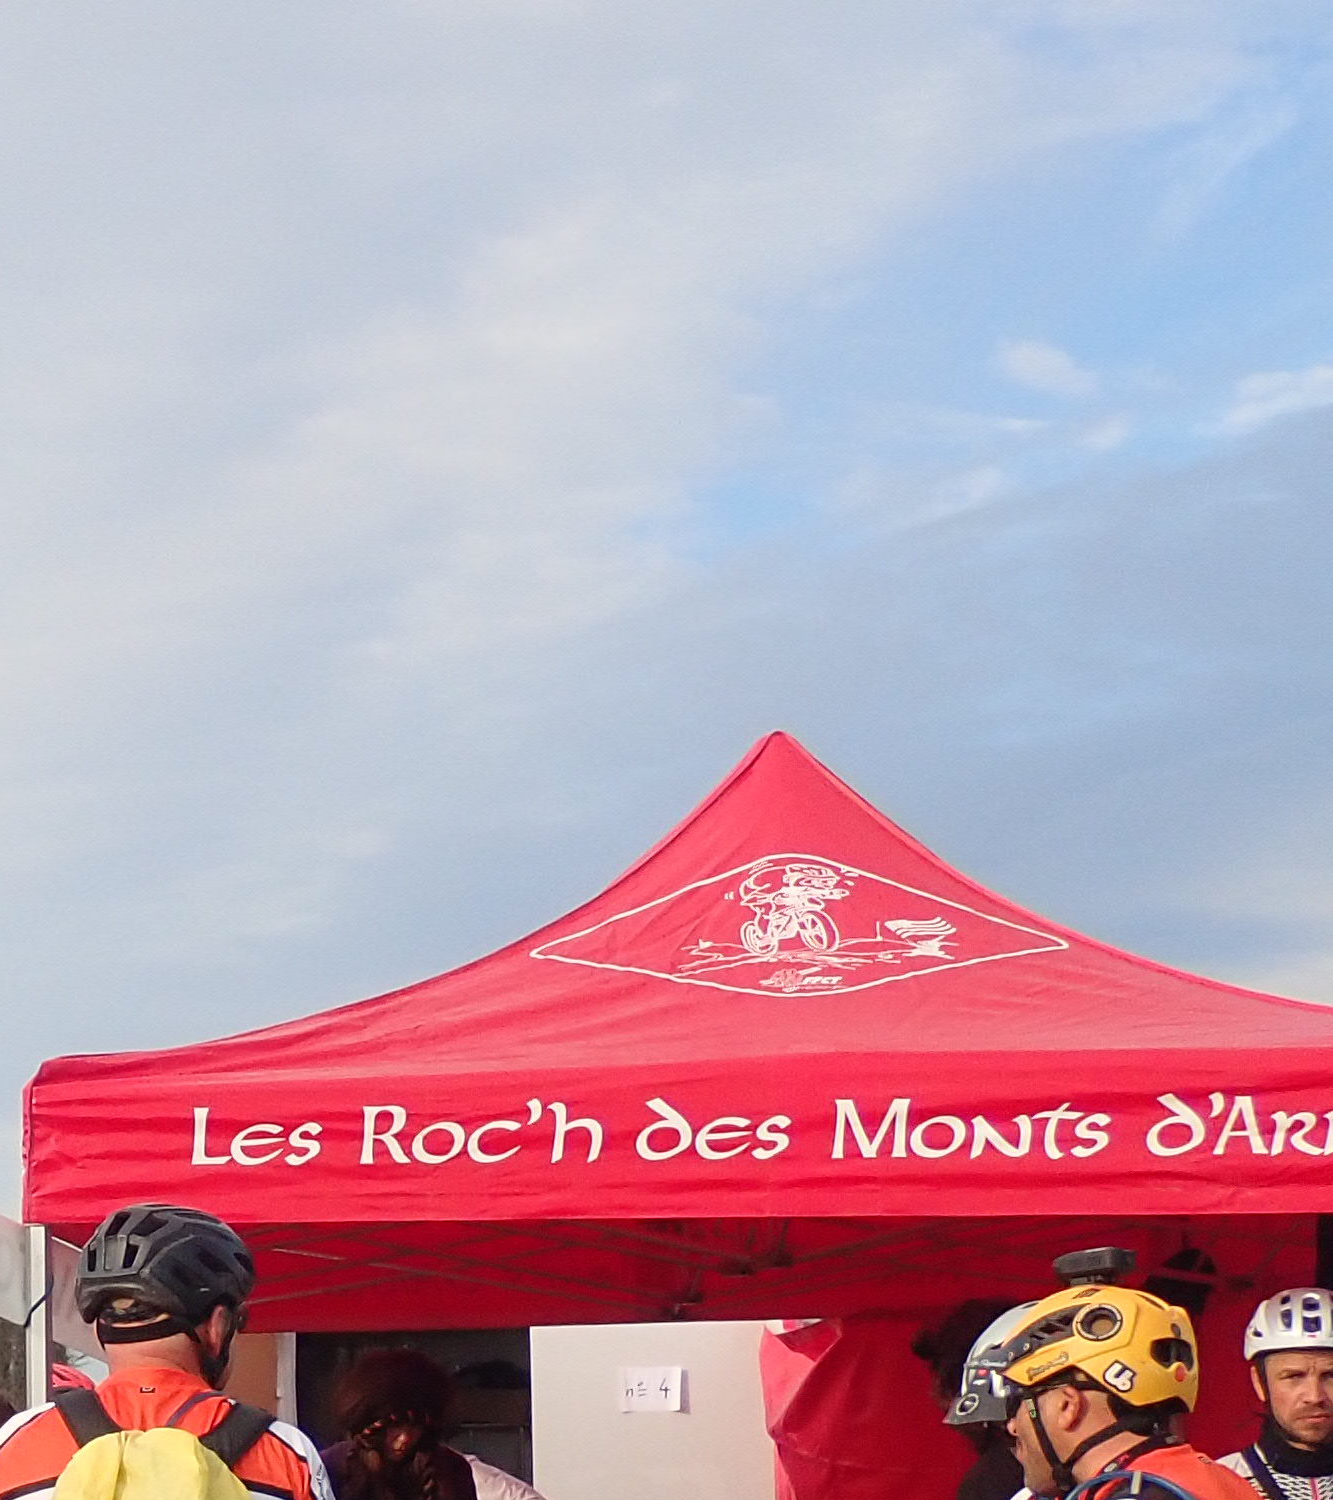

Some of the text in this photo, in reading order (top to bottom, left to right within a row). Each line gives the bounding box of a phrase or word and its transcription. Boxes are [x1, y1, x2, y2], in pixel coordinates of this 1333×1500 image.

[190, 1092, 1333, 1166] Les Roc'h des Monts d'Ar
[659, 1377, 672, 1400] 4
